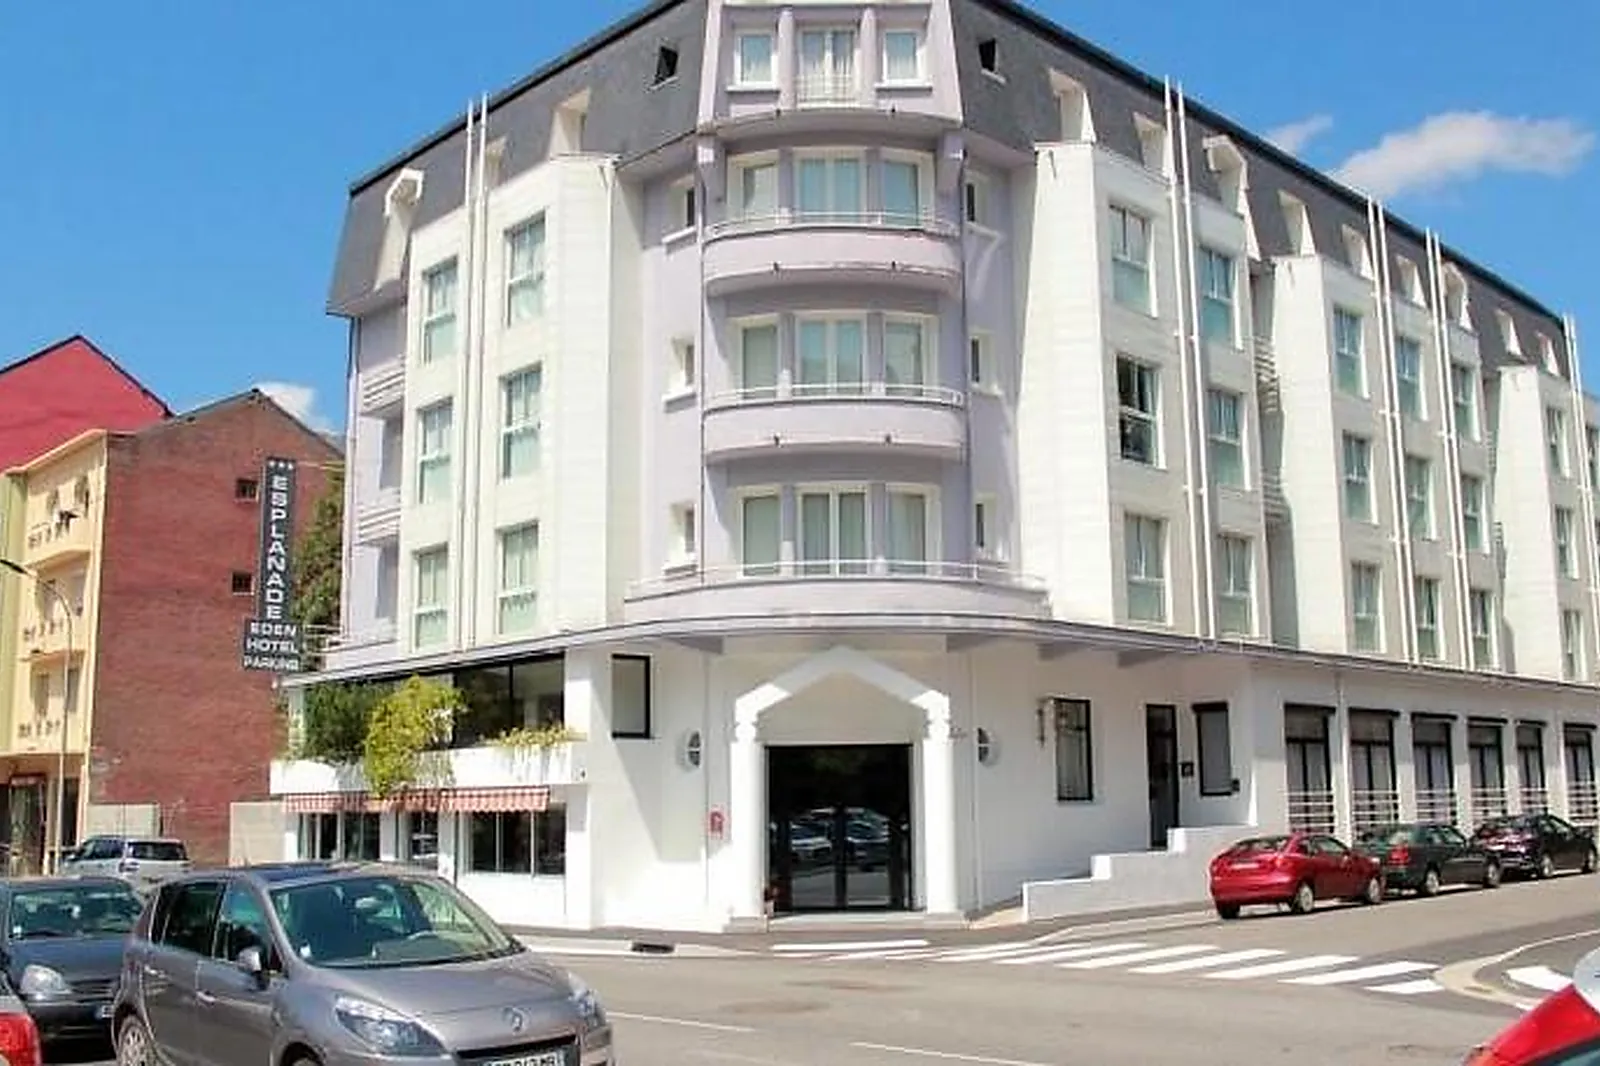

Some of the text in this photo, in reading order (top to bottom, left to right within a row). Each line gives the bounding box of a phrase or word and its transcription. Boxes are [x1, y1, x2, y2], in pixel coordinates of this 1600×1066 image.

[265, 475, 289, 619] ESPLANADE
[250, 622, 297, 637] EDEN
[246, 637, 299, 654] HOTEL
